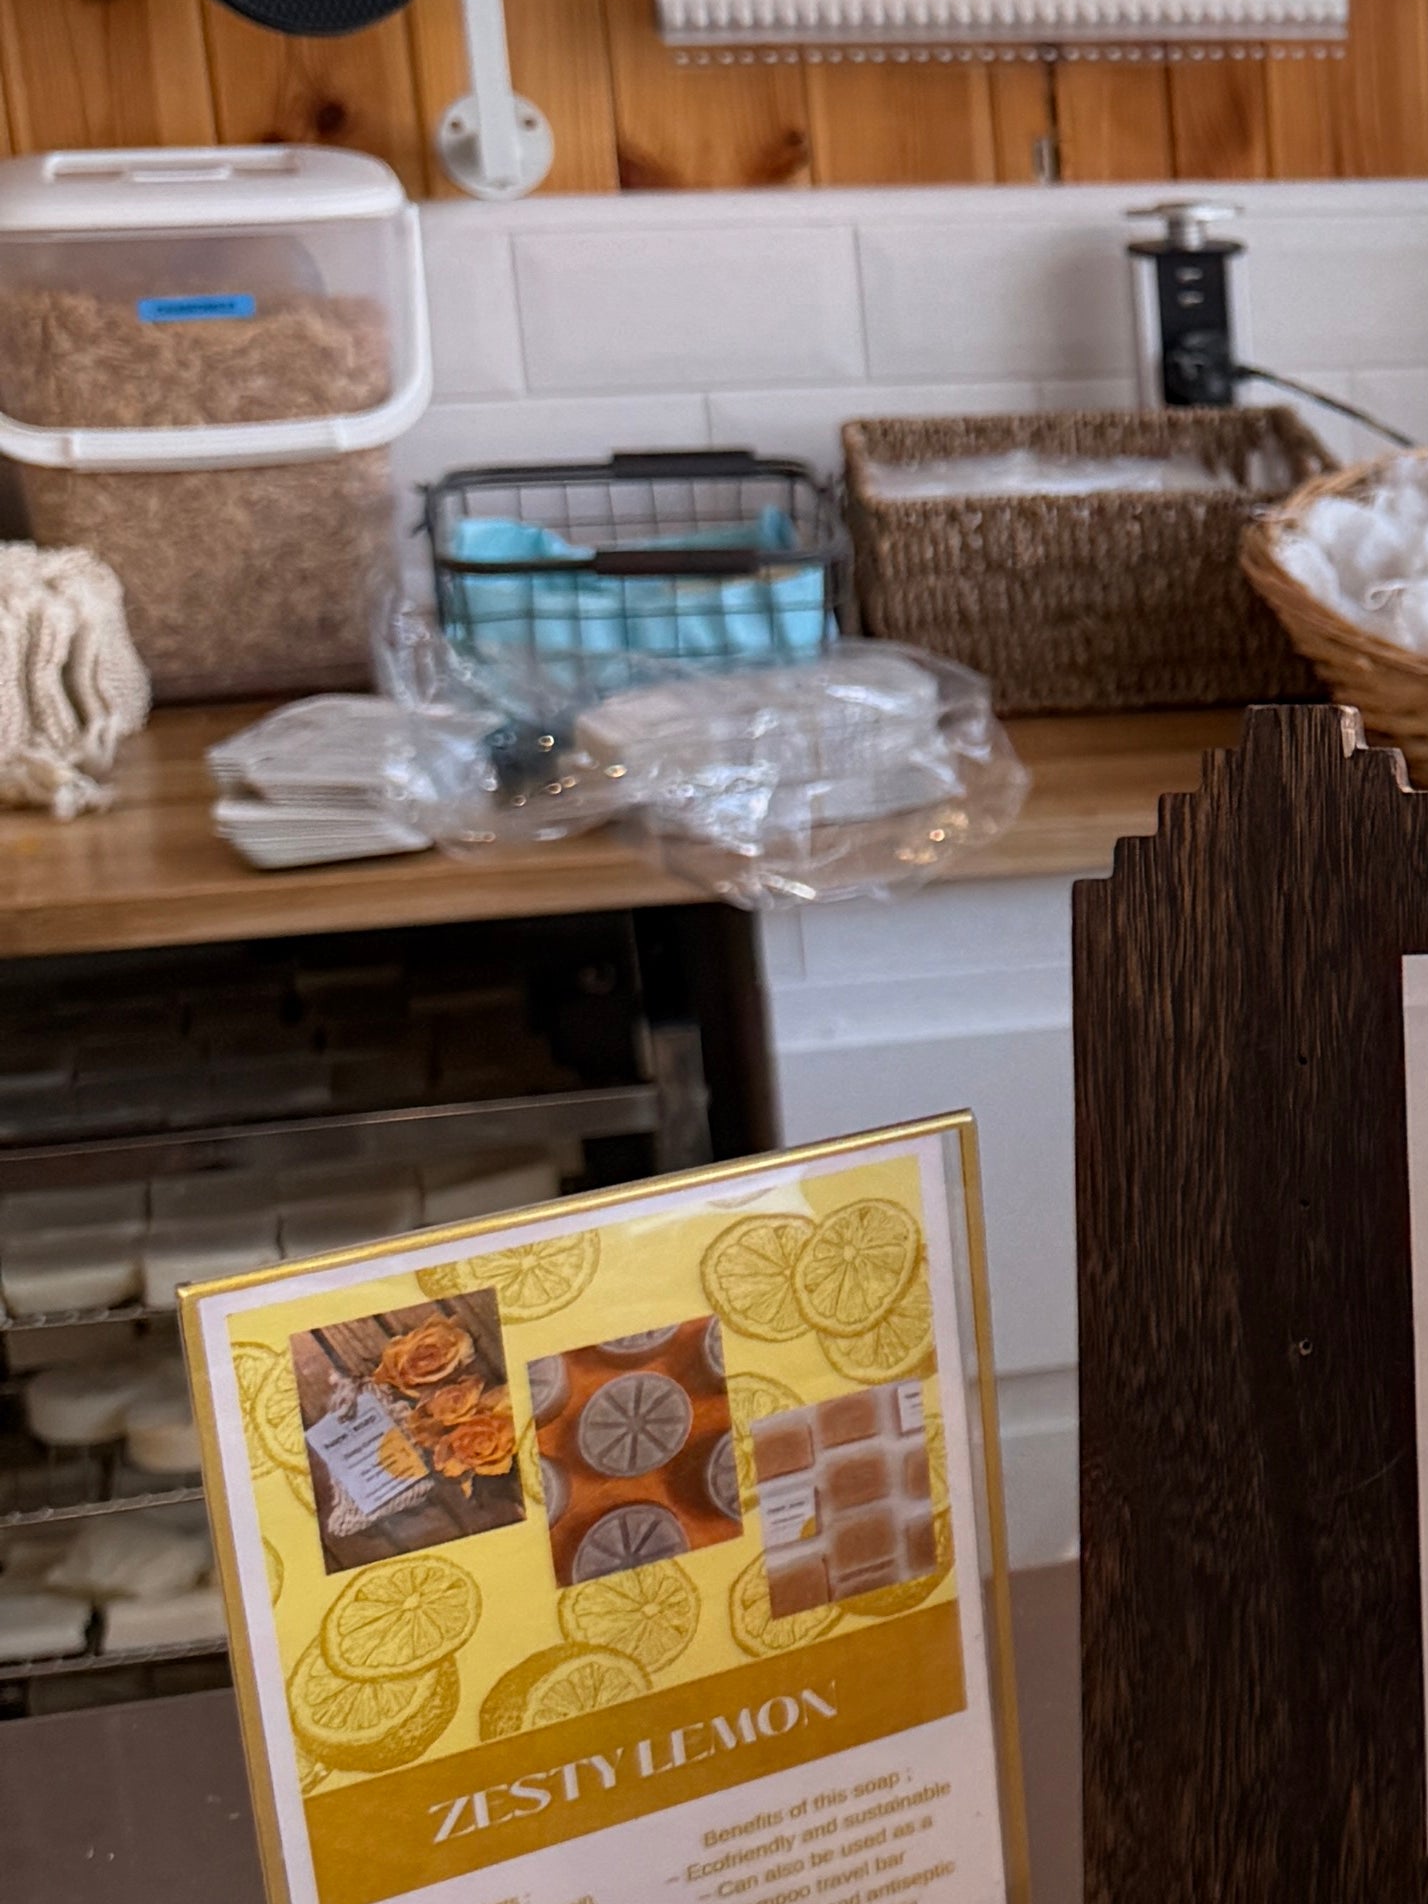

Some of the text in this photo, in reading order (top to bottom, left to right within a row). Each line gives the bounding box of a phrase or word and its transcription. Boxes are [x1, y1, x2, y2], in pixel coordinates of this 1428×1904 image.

[428, 1679, 838, 1845] ZESTY LEMON
[686, 1780, 951, 1883] Ecofriendly and sustainable
[703, 1809, 784, 1847] Benefits
[812, 1788, 848, 1810] this
[853, 1770, 900, 1798] soap
[717, 1875, 759, 1898] Can
[764, 1857, 805, 1883] also
[810, 1848, 835, 1868] be
[840, 1827, 887, 1856] used
[893, 1821, 915, 1838] as
[816, 1863, 870, 1893] travel
[875, 1849, 906, 1873] bar
[866, 1859, 955, 1901] antiseptic
